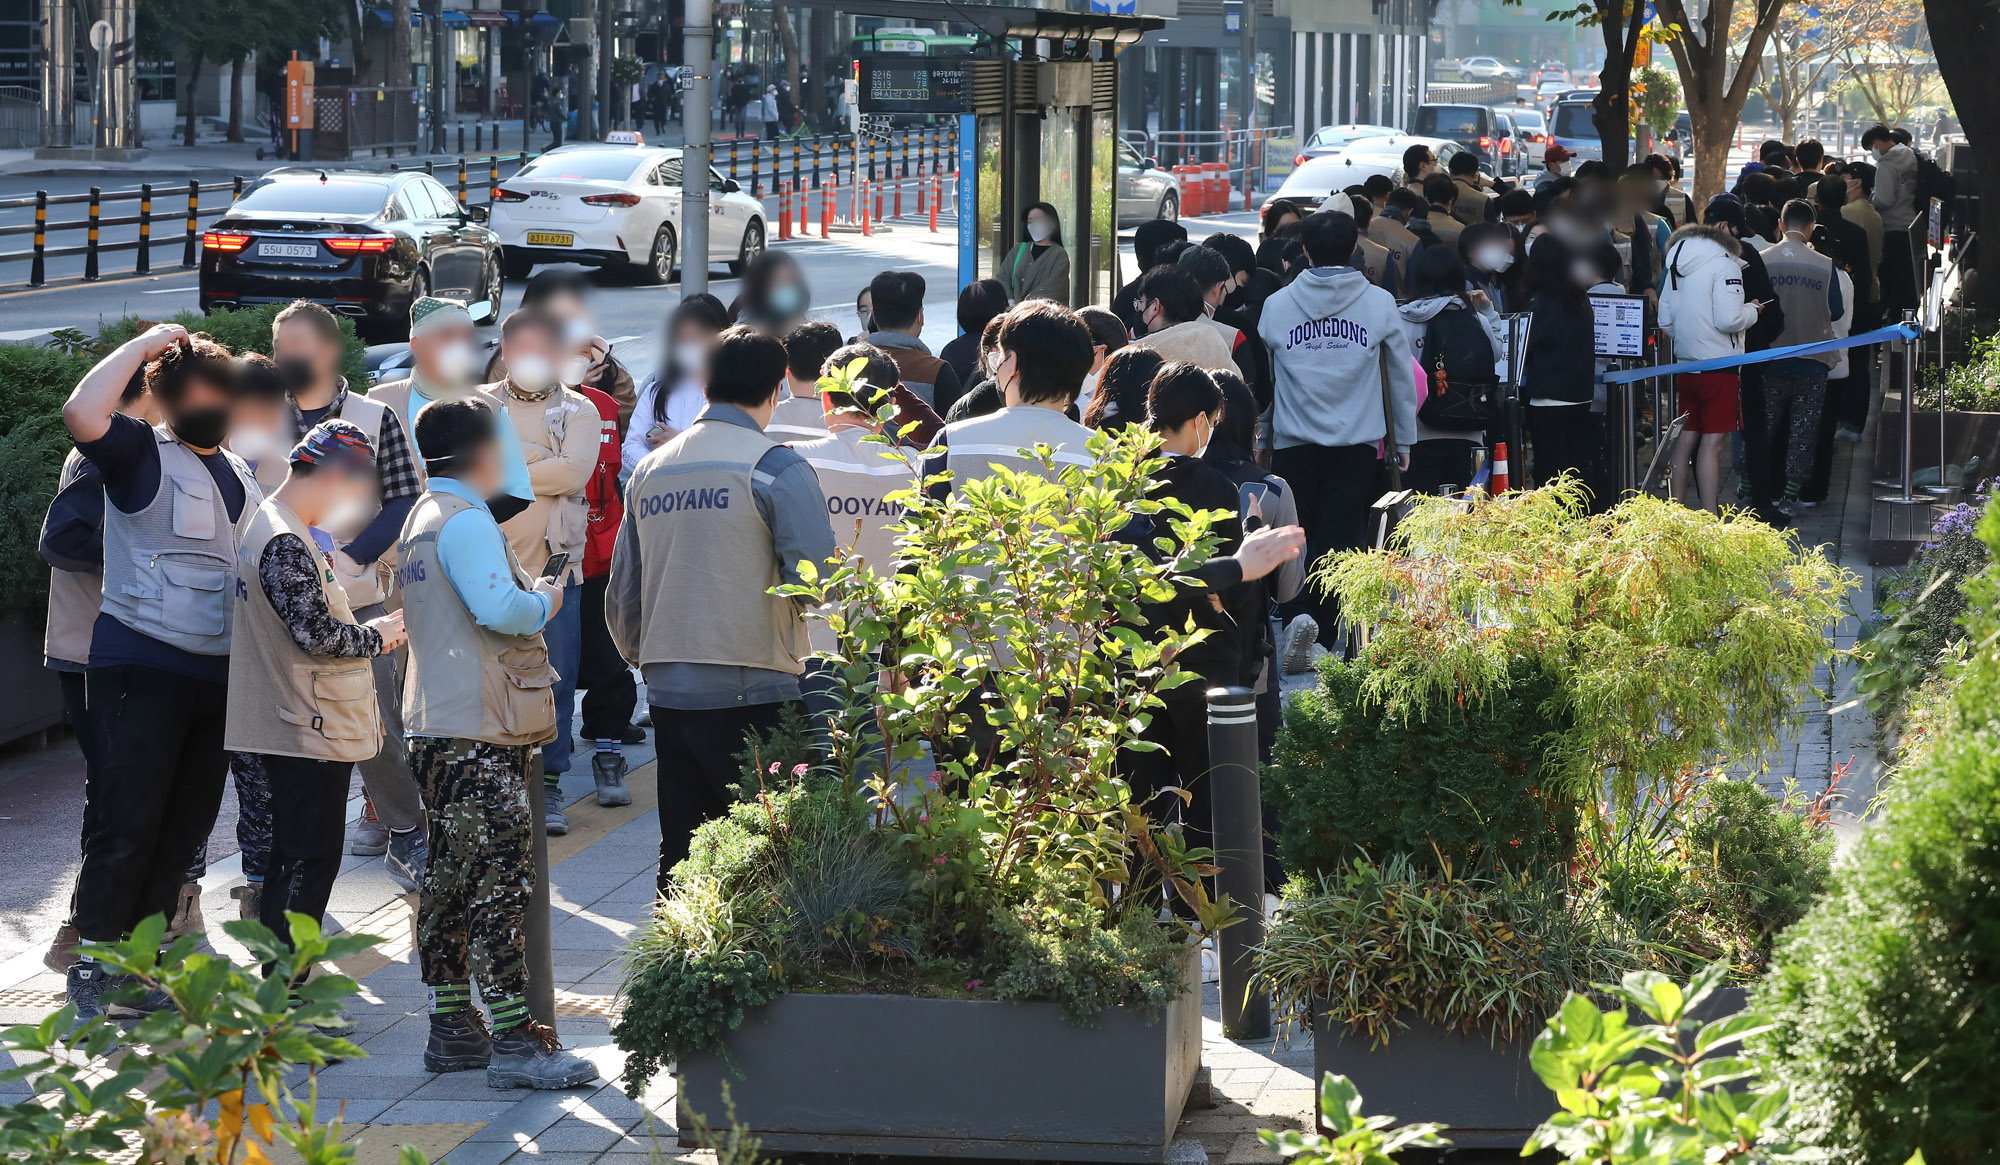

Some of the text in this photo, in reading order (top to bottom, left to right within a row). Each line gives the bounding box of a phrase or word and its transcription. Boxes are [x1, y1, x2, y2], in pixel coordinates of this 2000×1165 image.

[286, 245, 313, 256] 0573
[1770, 275, 1823, 290] DOOYANG
[1286, 317, 1368, 351] JOONGDONG
[1304, 342, 1350, 351] High School
[640, 487, 730, 520] DOOYANG
[827, 496, 905, 516] OOYAN
